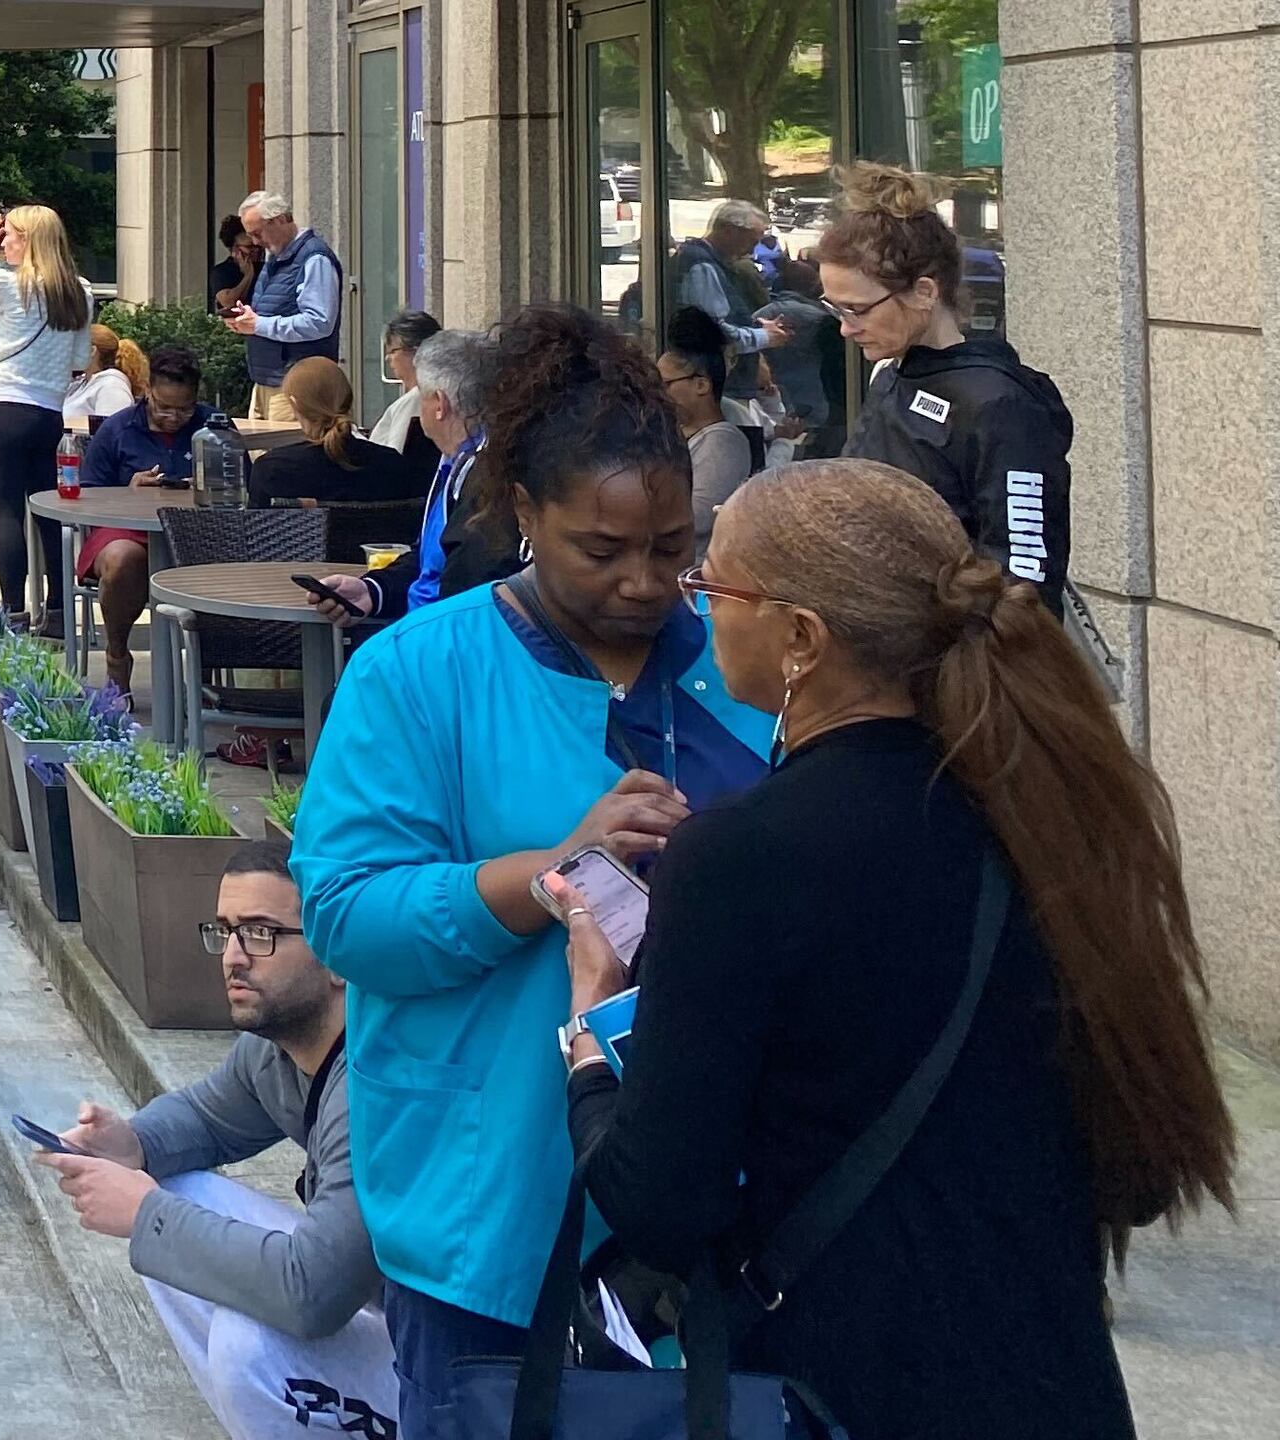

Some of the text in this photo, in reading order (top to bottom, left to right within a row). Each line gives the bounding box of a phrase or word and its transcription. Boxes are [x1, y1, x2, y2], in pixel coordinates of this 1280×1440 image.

[970, 80, 1002, 144] OP
[916, 395, 945, 416] PUMA
[1007, 470, 1048, 583] PUMA
